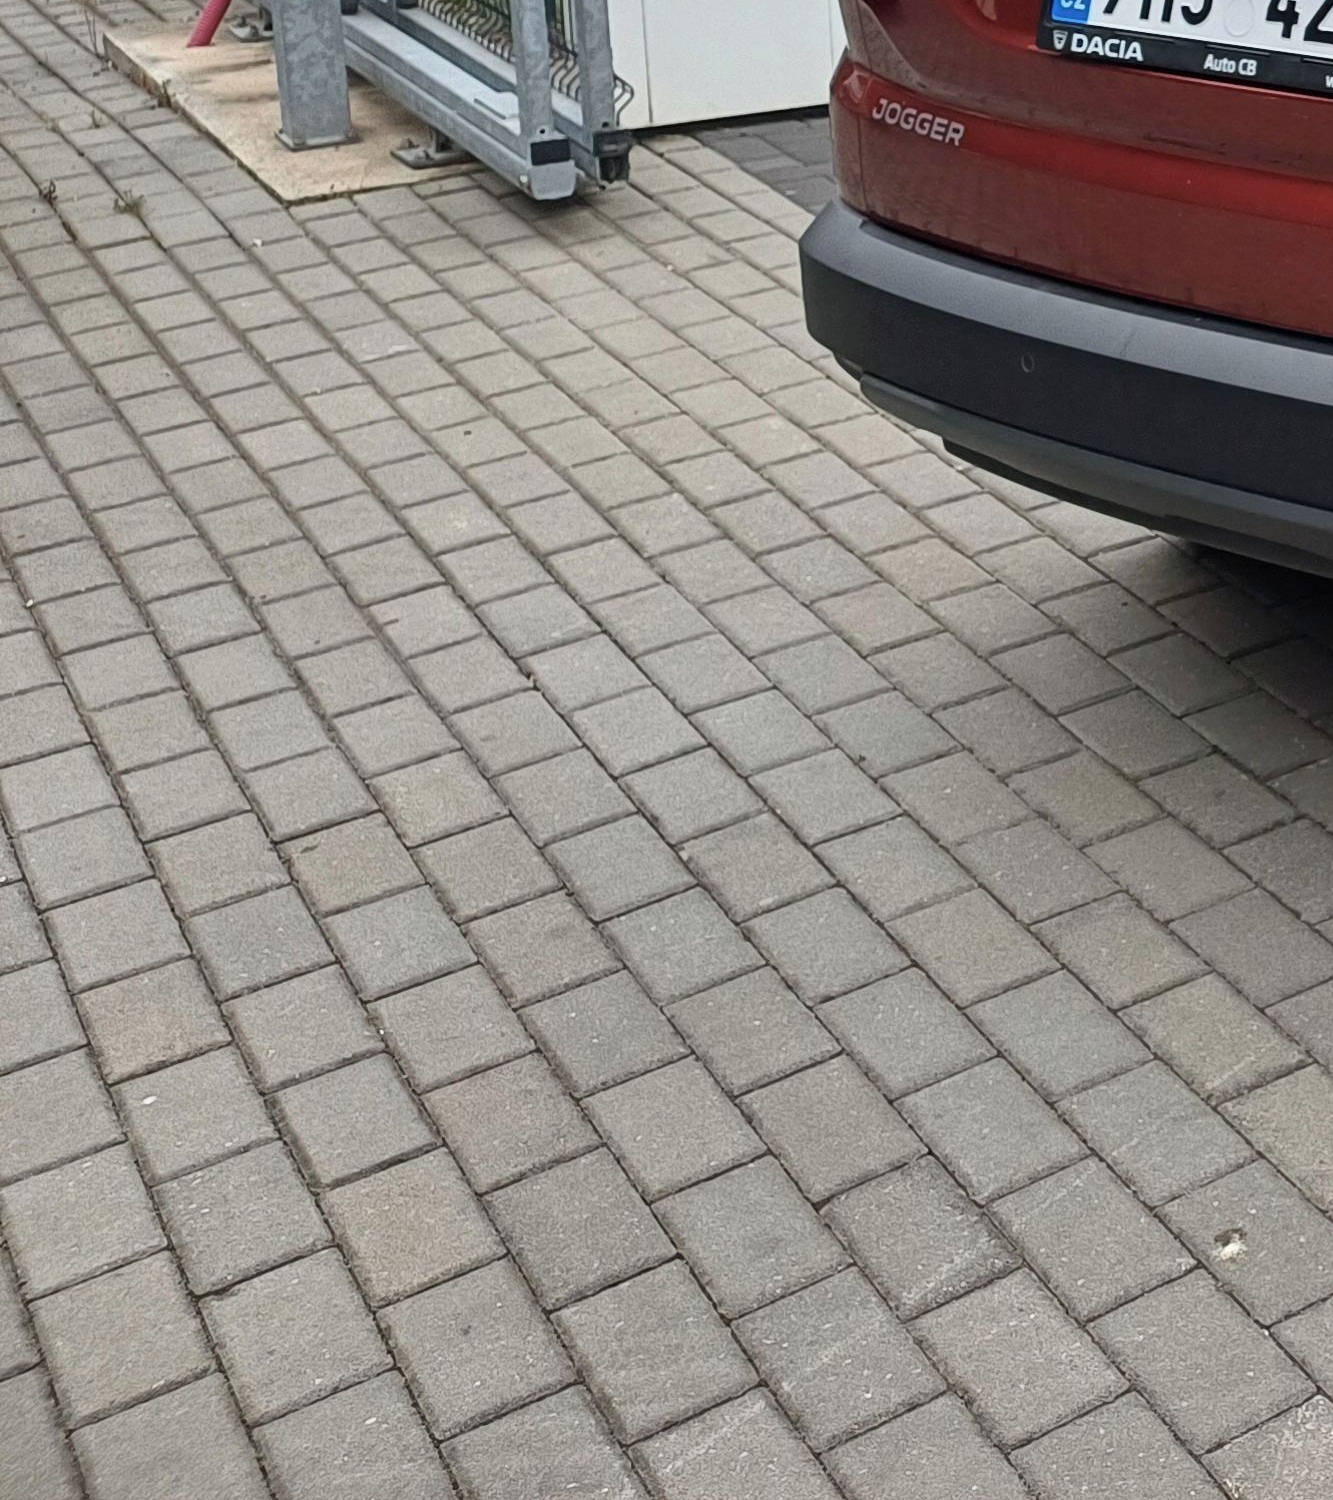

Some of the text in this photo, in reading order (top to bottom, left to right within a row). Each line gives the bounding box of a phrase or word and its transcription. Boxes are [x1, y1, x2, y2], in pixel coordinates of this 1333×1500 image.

[1070, 33, 1144, 62] DACIA
[1203, 53, 1257, 77] Auto CB
[872, 98, 965, 147] JOGGER
